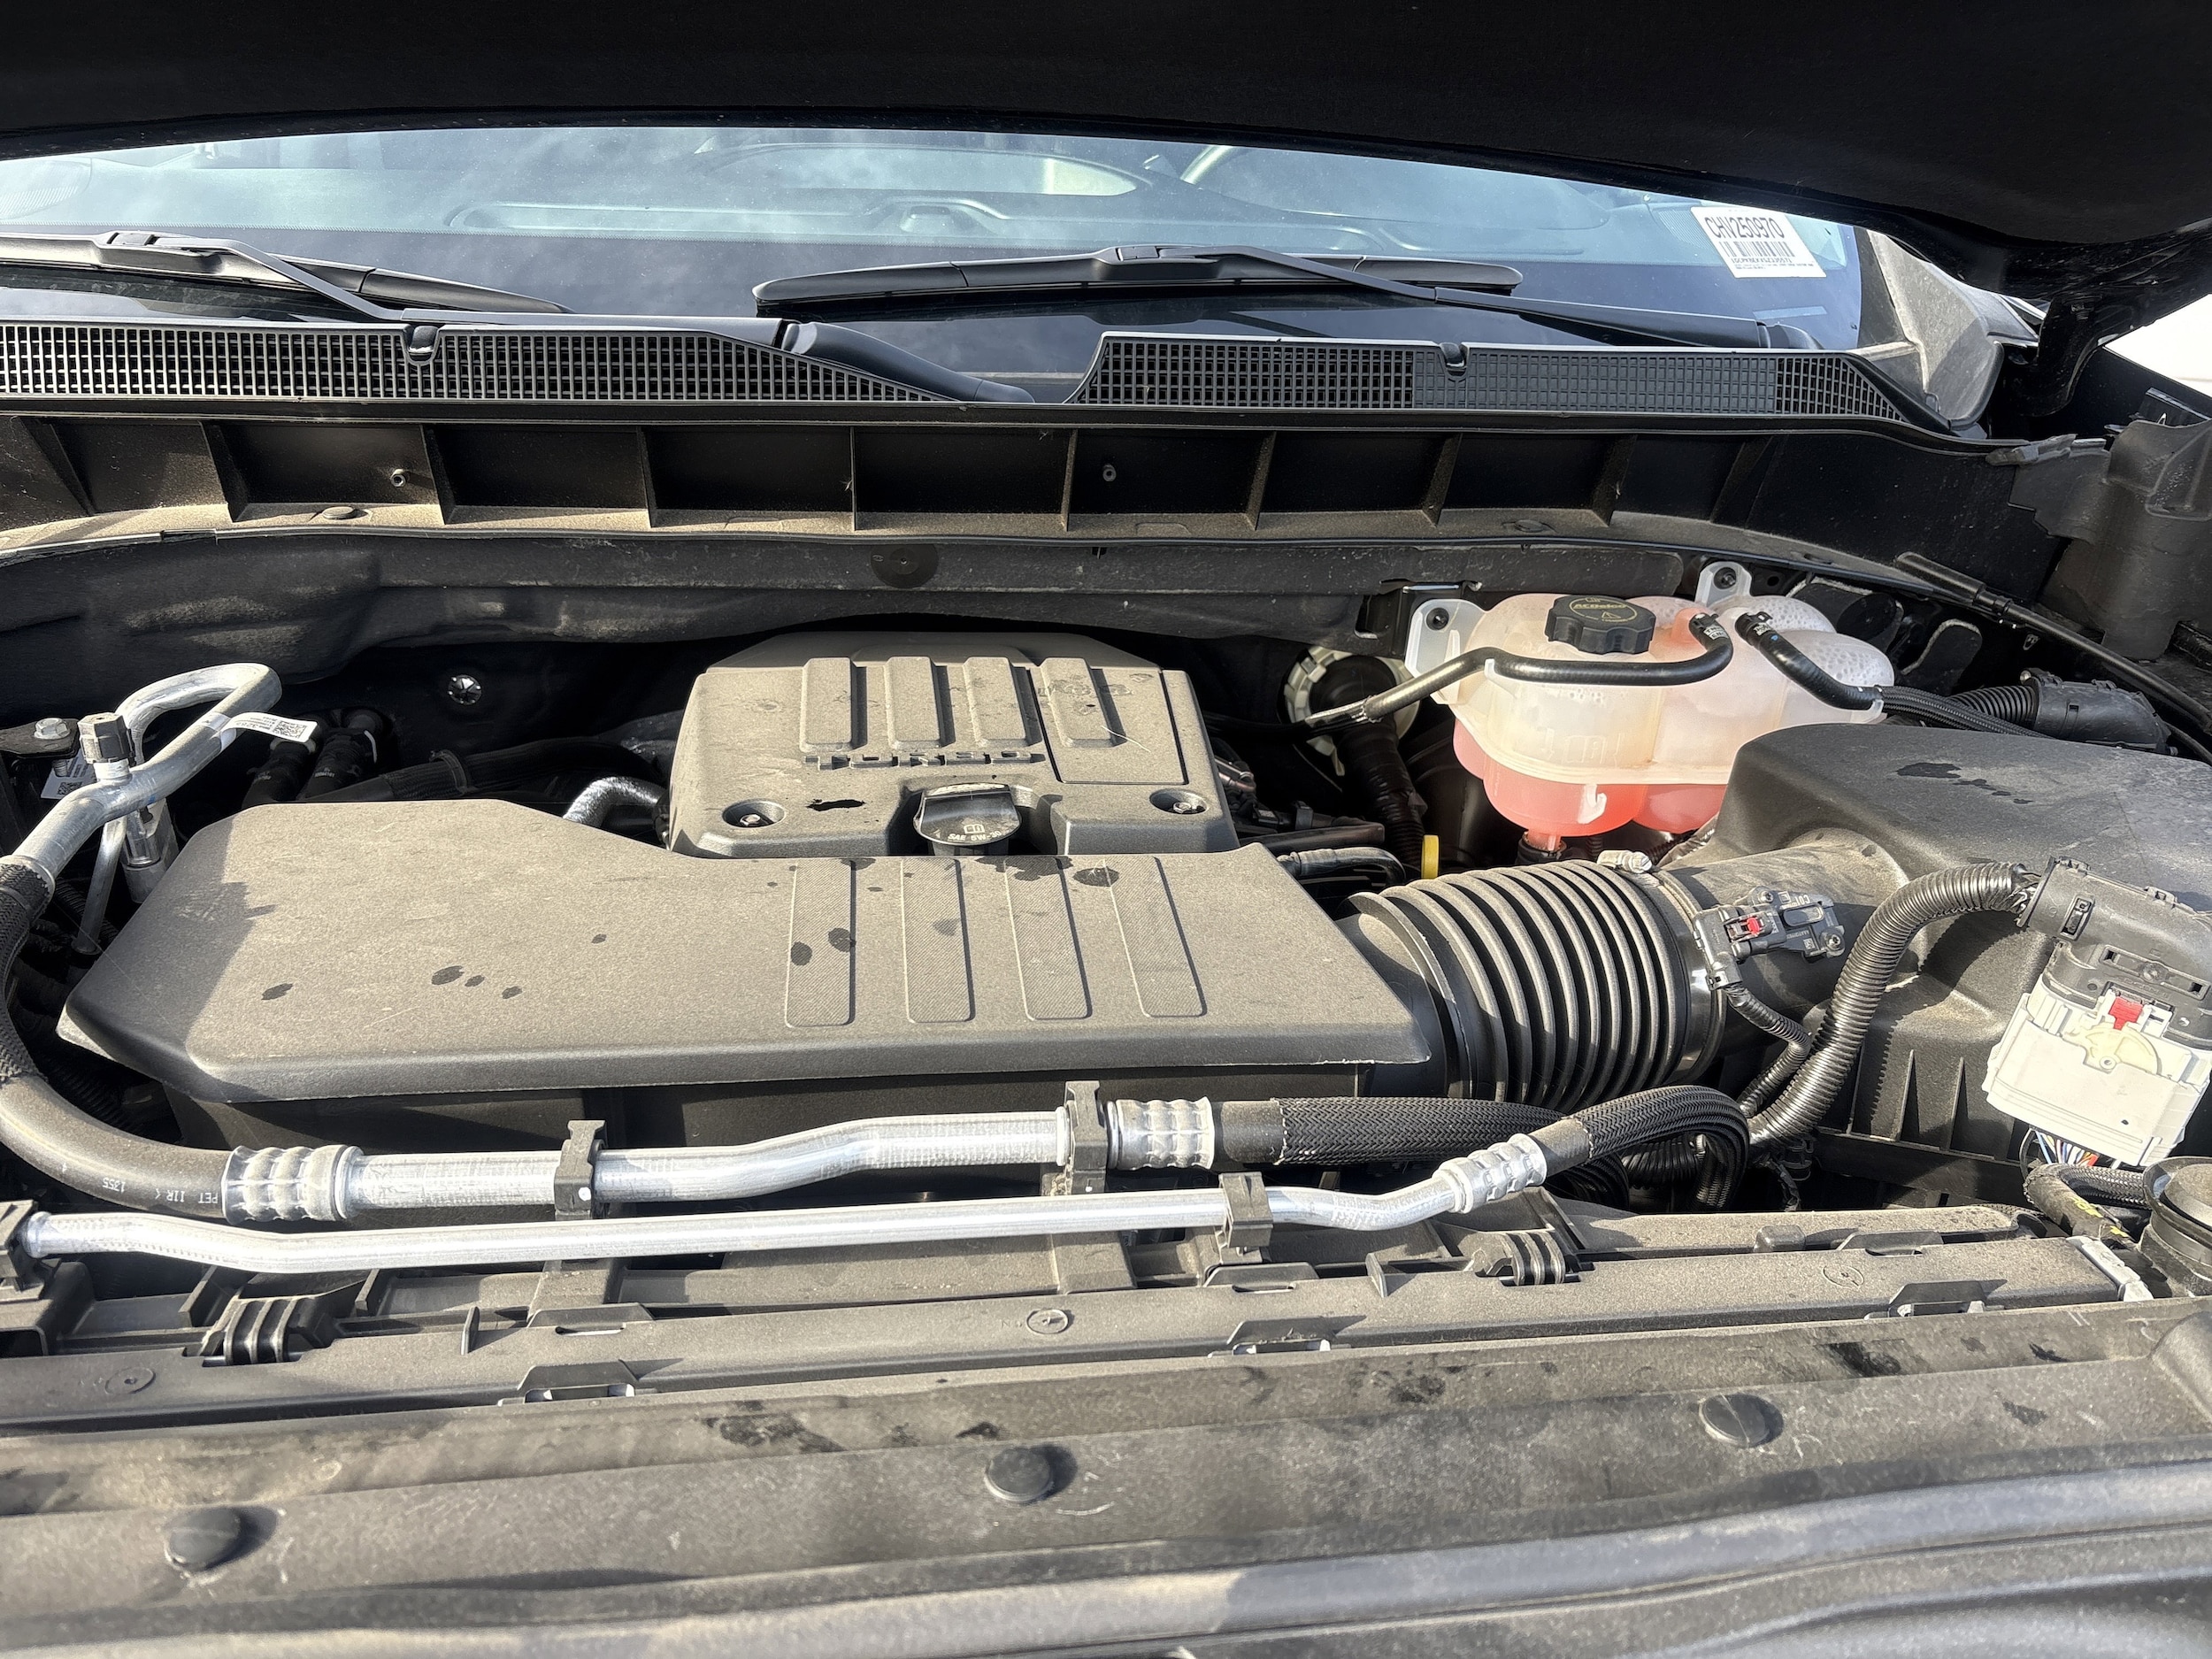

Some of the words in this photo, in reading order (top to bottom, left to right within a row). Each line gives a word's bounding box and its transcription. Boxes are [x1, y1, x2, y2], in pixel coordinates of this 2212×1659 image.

[1704, 217, 1786, 239] CHV250970
[803, 750, 1040, 770] TURBO
[947, 833, 967, 841] SAE
[971, 830, 1002, 841] 5W-30
[197, 1191, 219, 1204] PET
